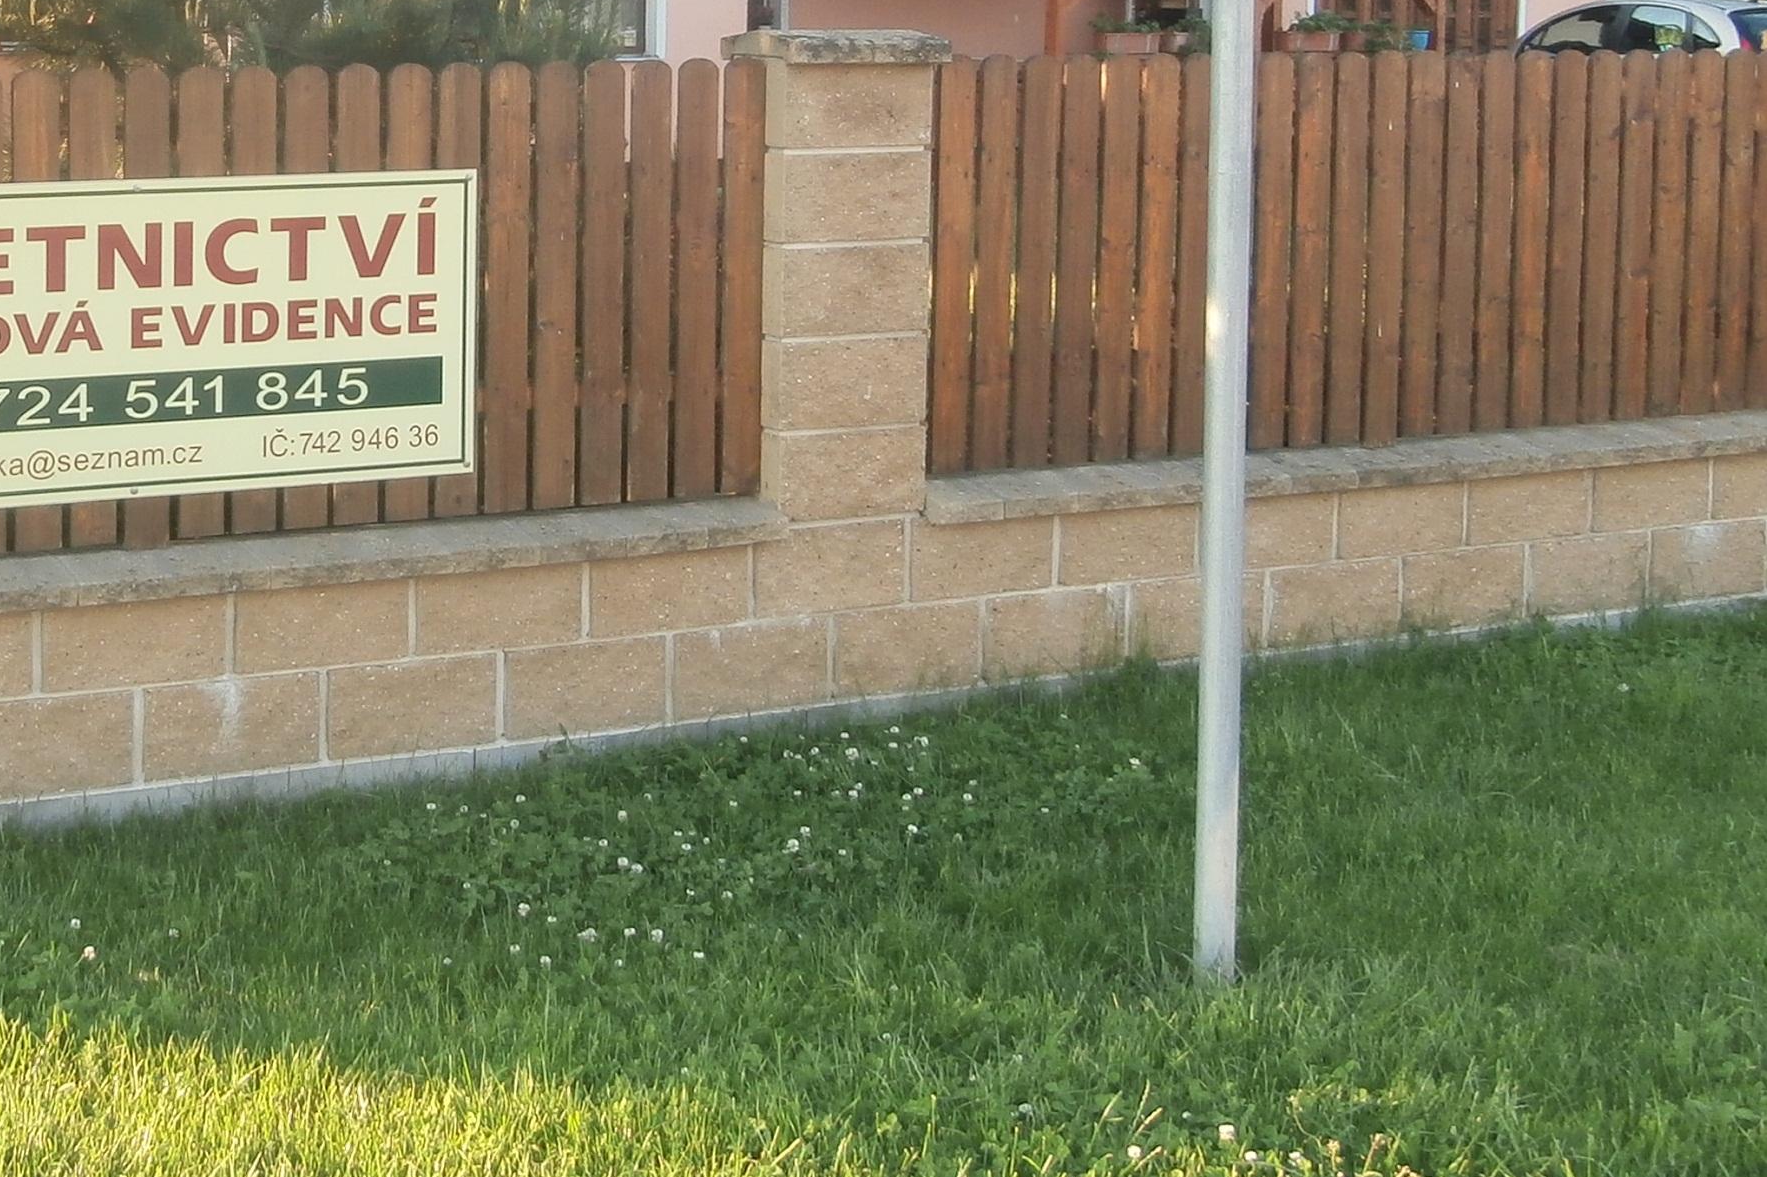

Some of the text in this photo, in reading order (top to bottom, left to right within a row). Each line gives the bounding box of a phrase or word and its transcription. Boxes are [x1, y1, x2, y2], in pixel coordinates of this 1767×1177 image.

[131, 293, 438, 349] EVIDENCE
[124, 375, 225, 419] 541
[255, 367, 369, 410] 845
[352, 427, 400, 451] 946
[409, 423, 439, 448] 36
